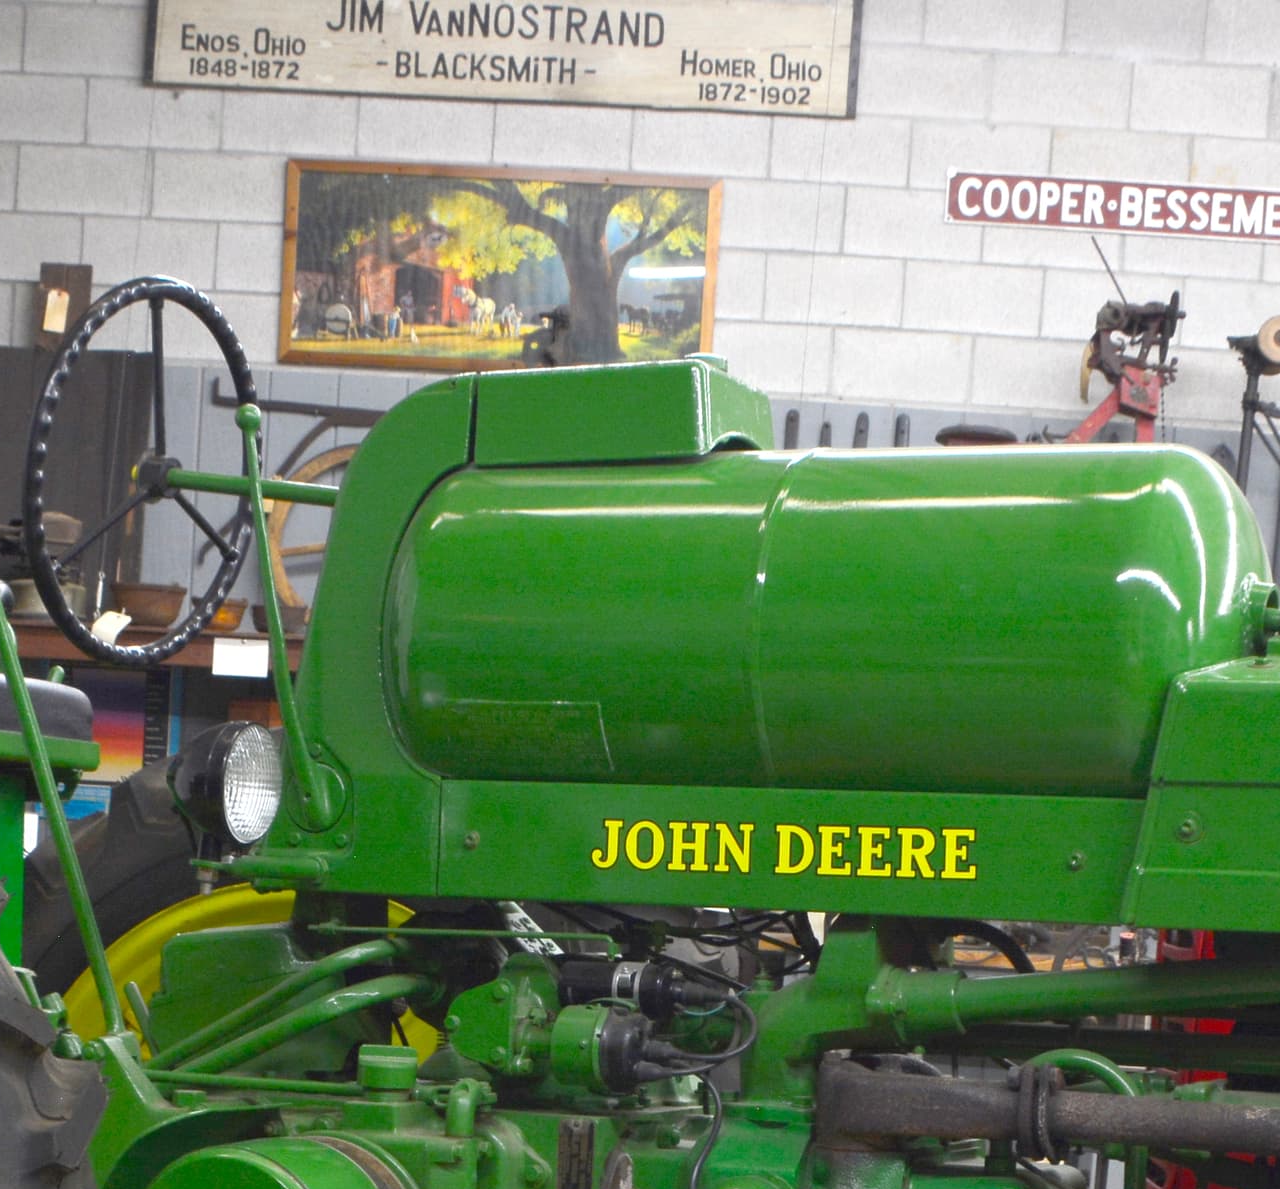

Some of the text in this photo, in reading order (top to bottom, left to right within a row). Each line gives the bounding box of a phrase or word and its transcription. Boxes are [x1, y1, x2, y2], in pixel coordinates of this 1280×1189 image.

[326, 0, 384, 33] JIM
[189, 57, 300, 80] 1848-1872
[699, 82, 812, 105] 1872-1902
[590, 818, 978, 880] JOHN DEERE
